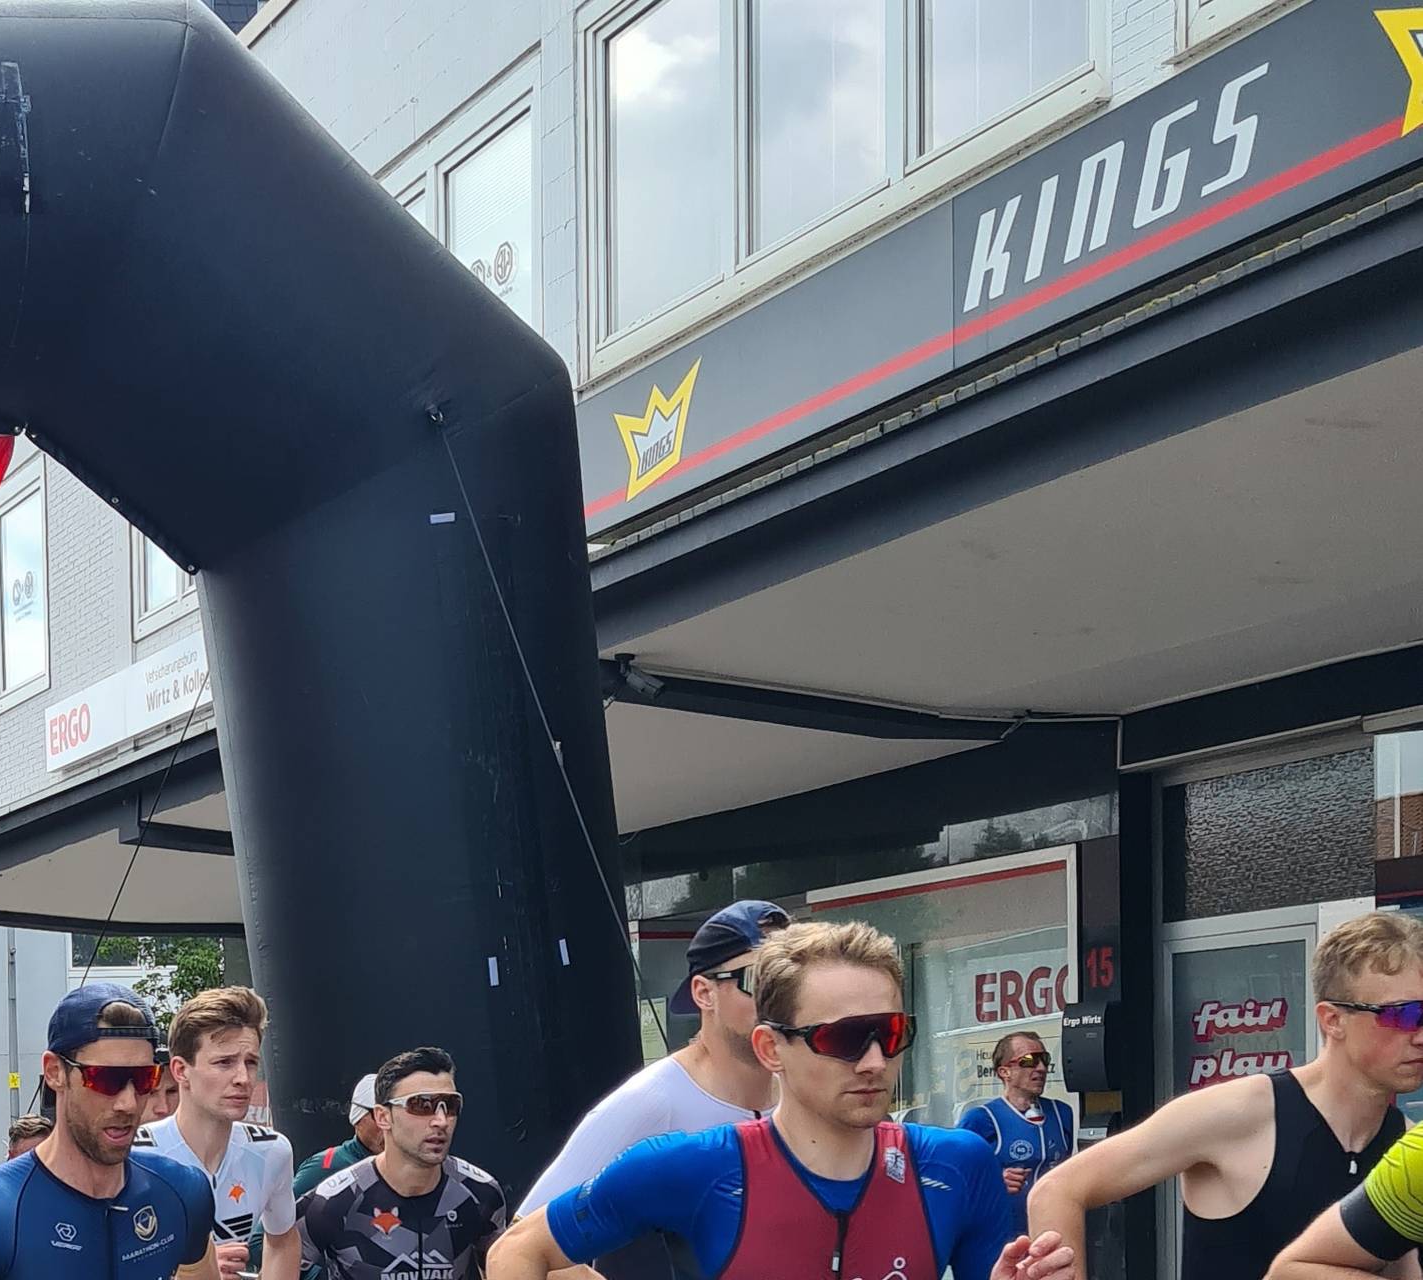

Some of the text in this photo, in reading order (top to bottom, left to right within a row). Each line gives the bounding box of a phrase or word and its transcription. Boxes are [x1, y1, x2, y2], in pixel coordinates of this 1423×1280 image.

[963, 62, 1270, 314] KINGS
[641, 430, 673, 473] KINGS
[146, 687, 170, 712] Wirtz
[172, 679, 180, 700] &
[49, 703, 91, 756] ERGO
[1086, 946, 1115, 988] 15
[1063, 1014, 1102, 1028] Ergo Wirtz
[1192, 1000, 1284, 1036] fair
